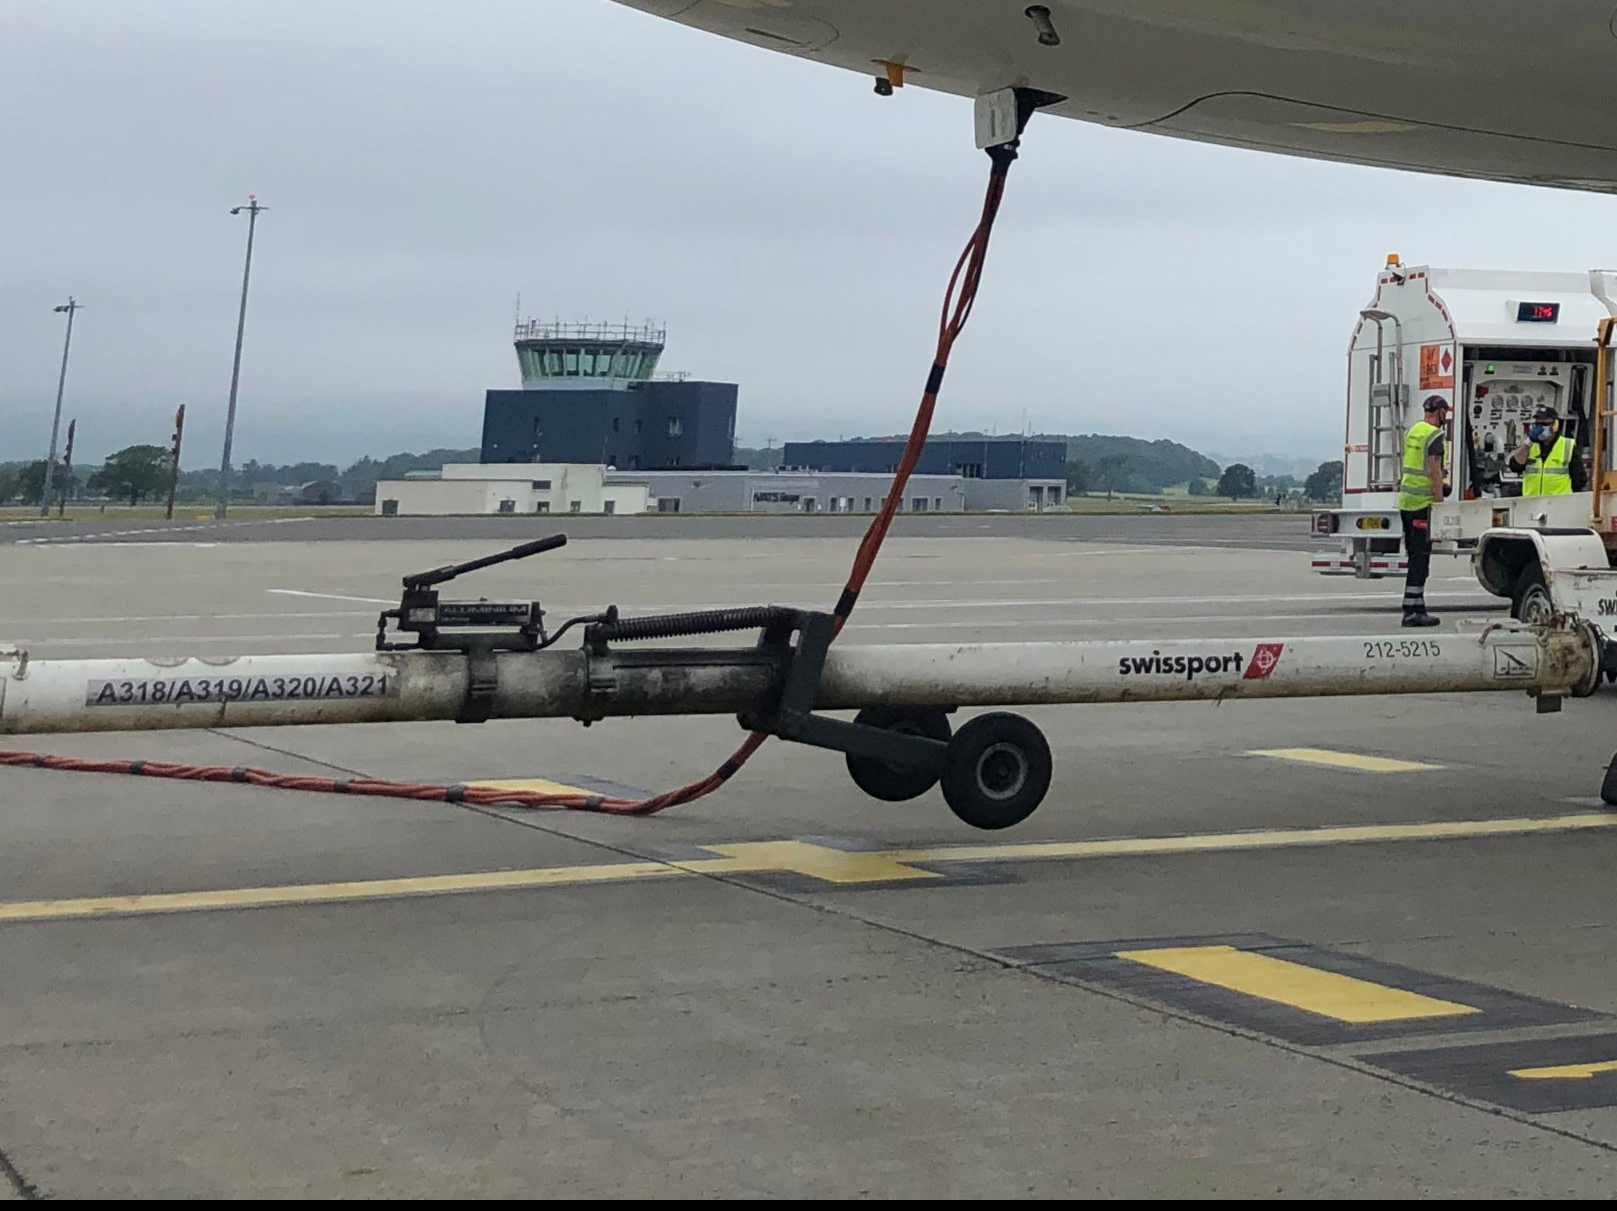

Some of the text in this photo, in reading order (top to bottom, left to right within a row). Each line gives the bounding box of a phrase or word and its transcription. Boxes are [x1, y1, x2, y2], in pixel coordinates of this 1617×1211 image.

[1363, 640, 1441, 659] 212-5215
[1118, 650, 1244, 680] swissport
[96, 675, 389, 704] A318/A319/A320/A321
